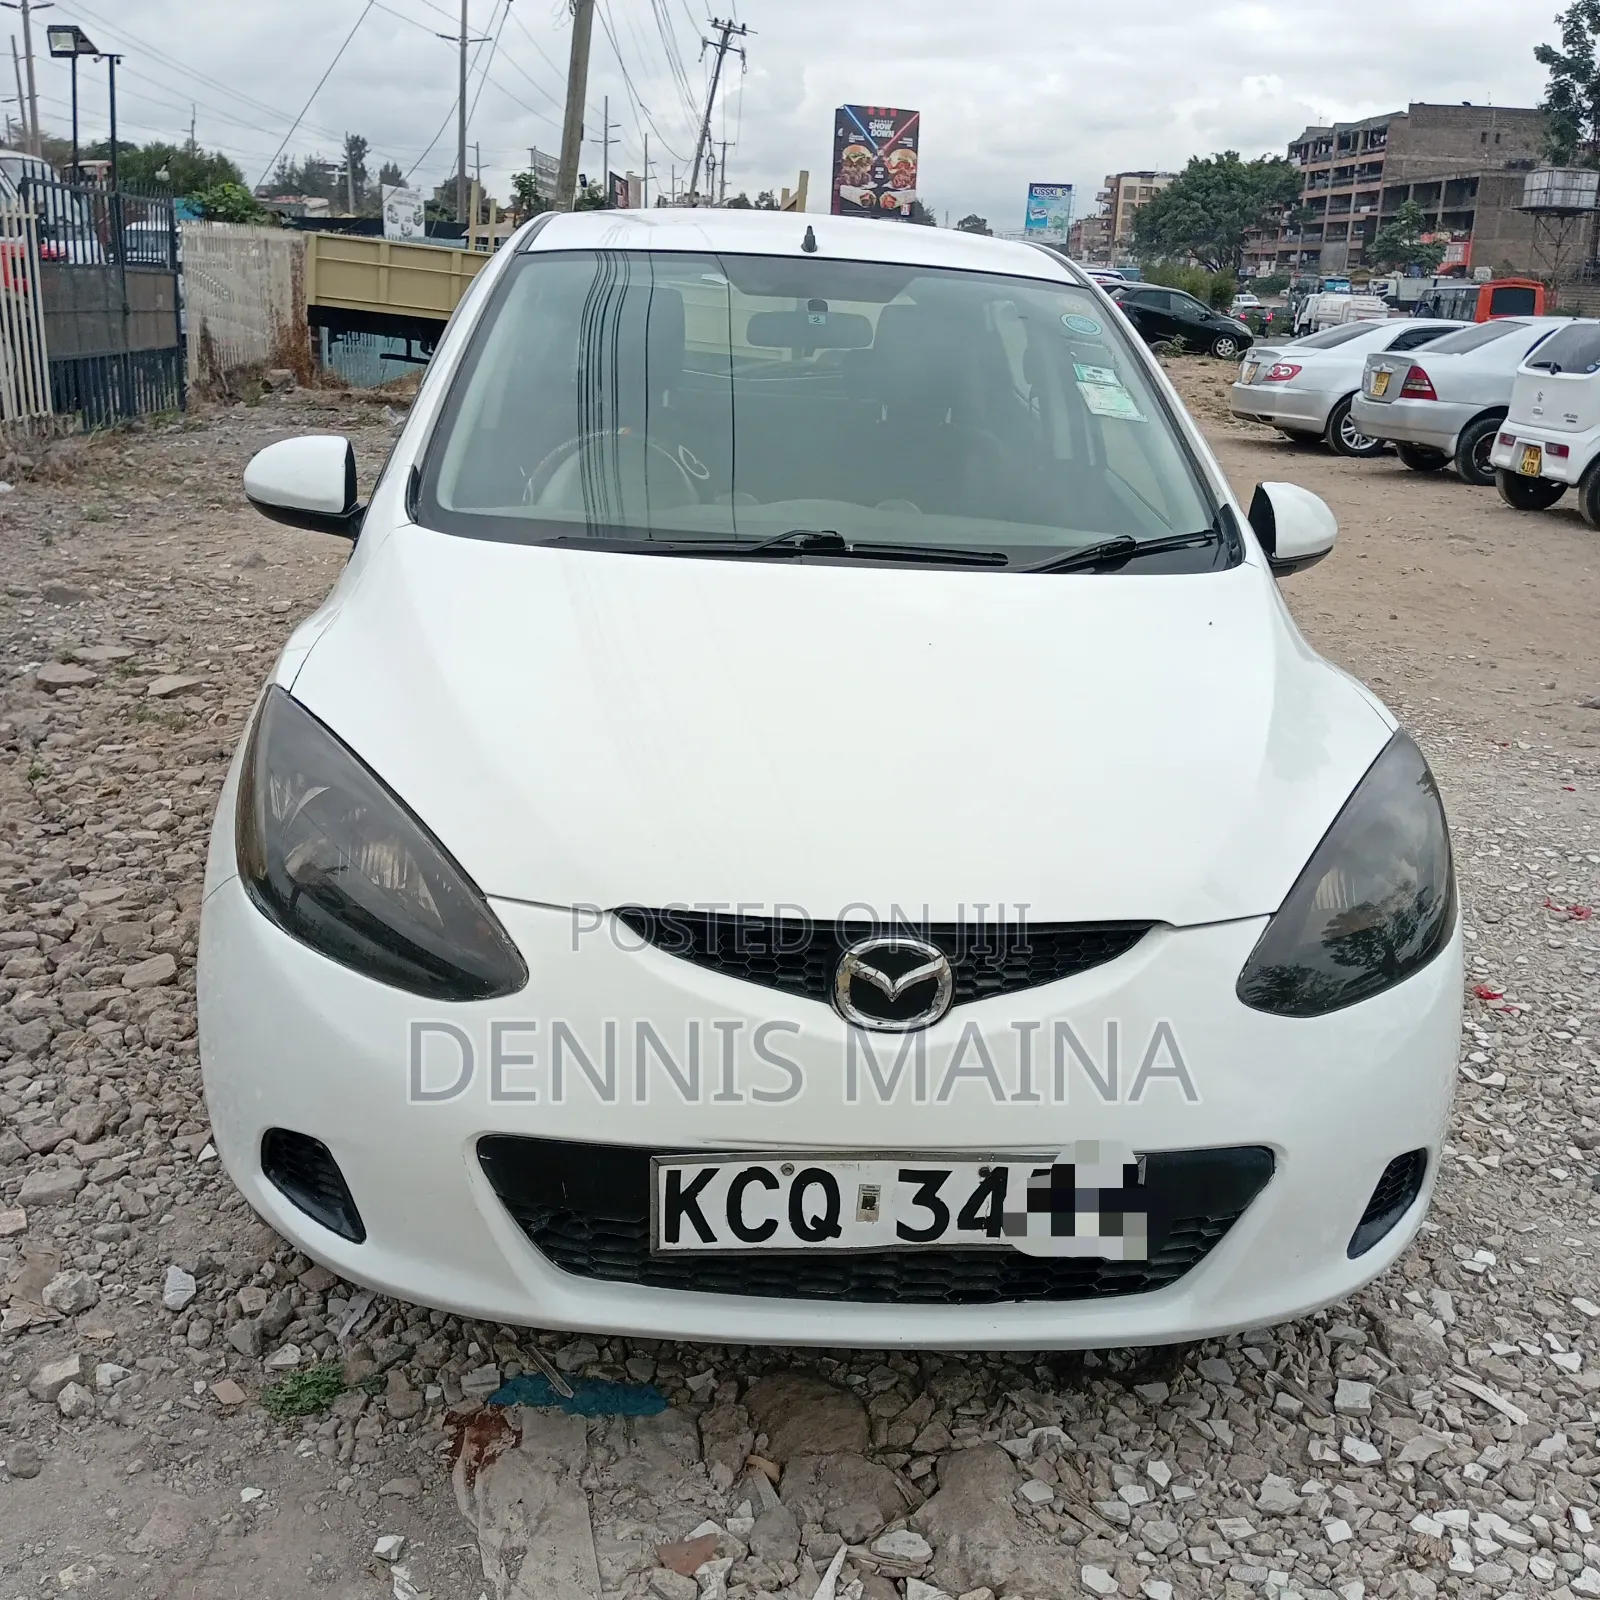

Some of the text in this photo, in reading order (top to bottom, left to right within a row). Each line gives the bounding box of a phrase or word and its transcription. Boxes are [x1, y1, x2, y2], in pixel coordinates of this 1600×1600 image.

[869, 121, 892, 130] SHOW
[871, 130, 895, 138] DOWN
[664, 1167, 842, 1243] KCQ
